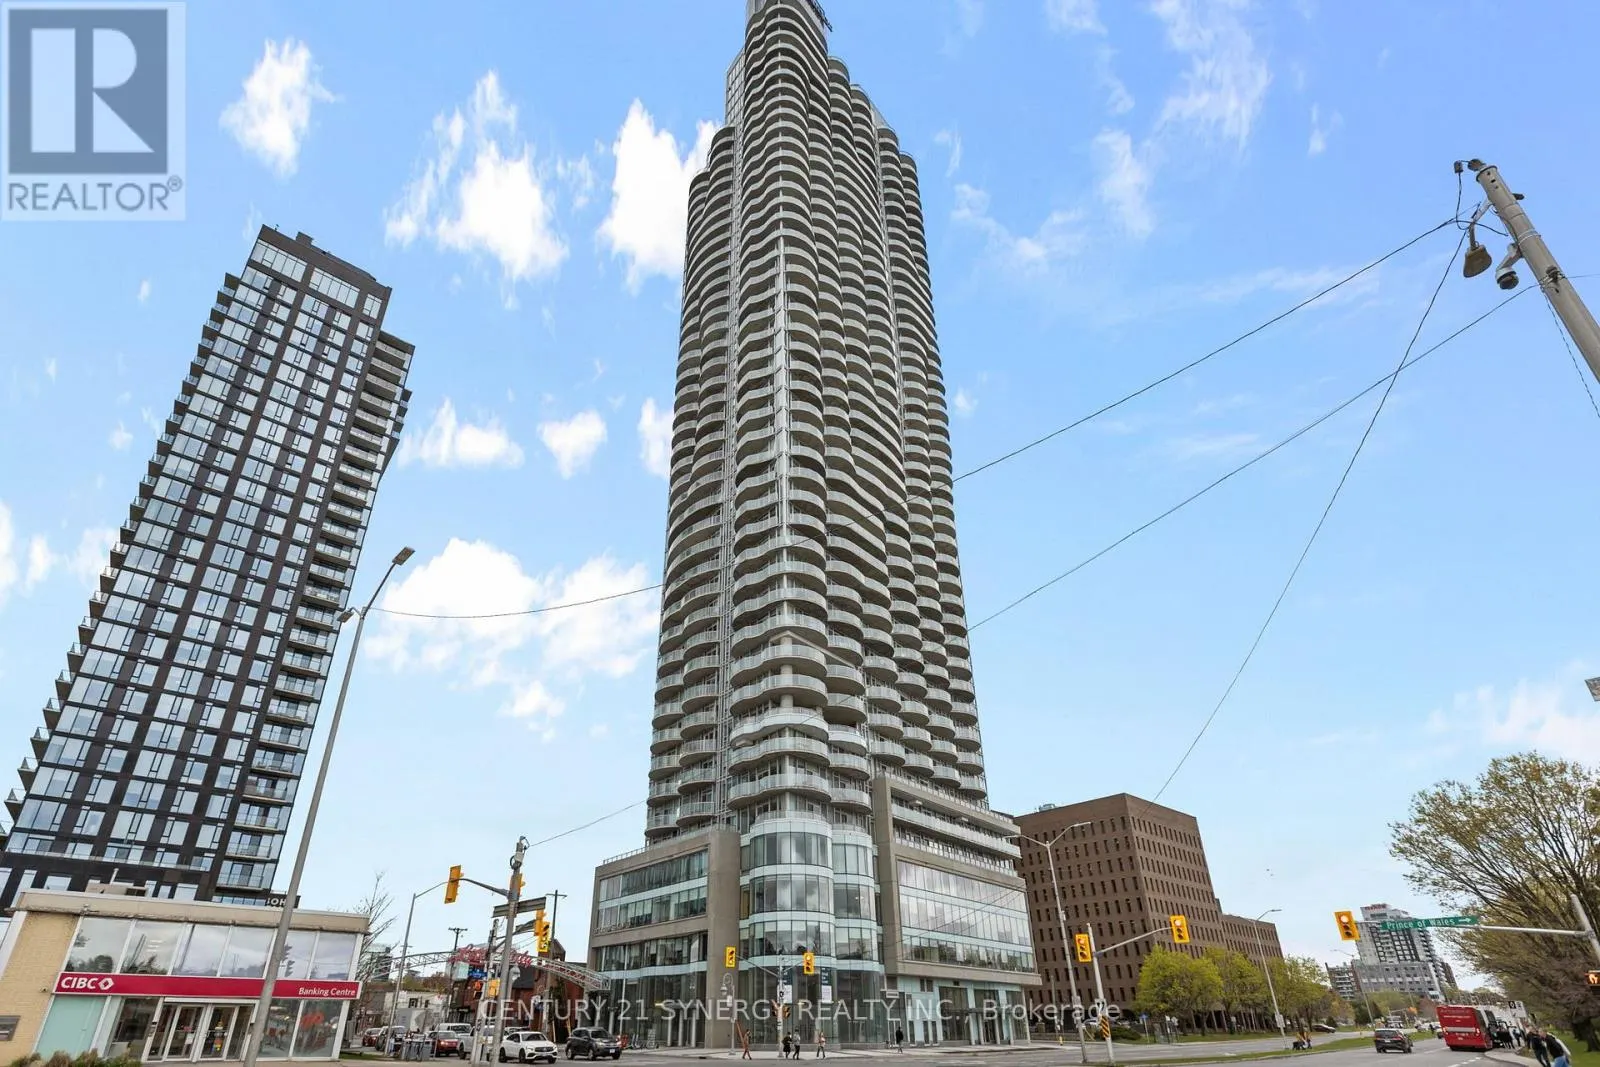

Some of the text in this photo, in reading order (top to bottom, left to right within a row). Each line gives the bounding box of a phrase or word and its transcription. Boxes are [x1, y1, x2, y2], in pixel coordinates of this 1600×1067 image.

[1386, 918, 1455, 931] Prince of Wales
[61, 976, 98, 989] CIBC
[298, 987, 356, 997] Banking Centre
